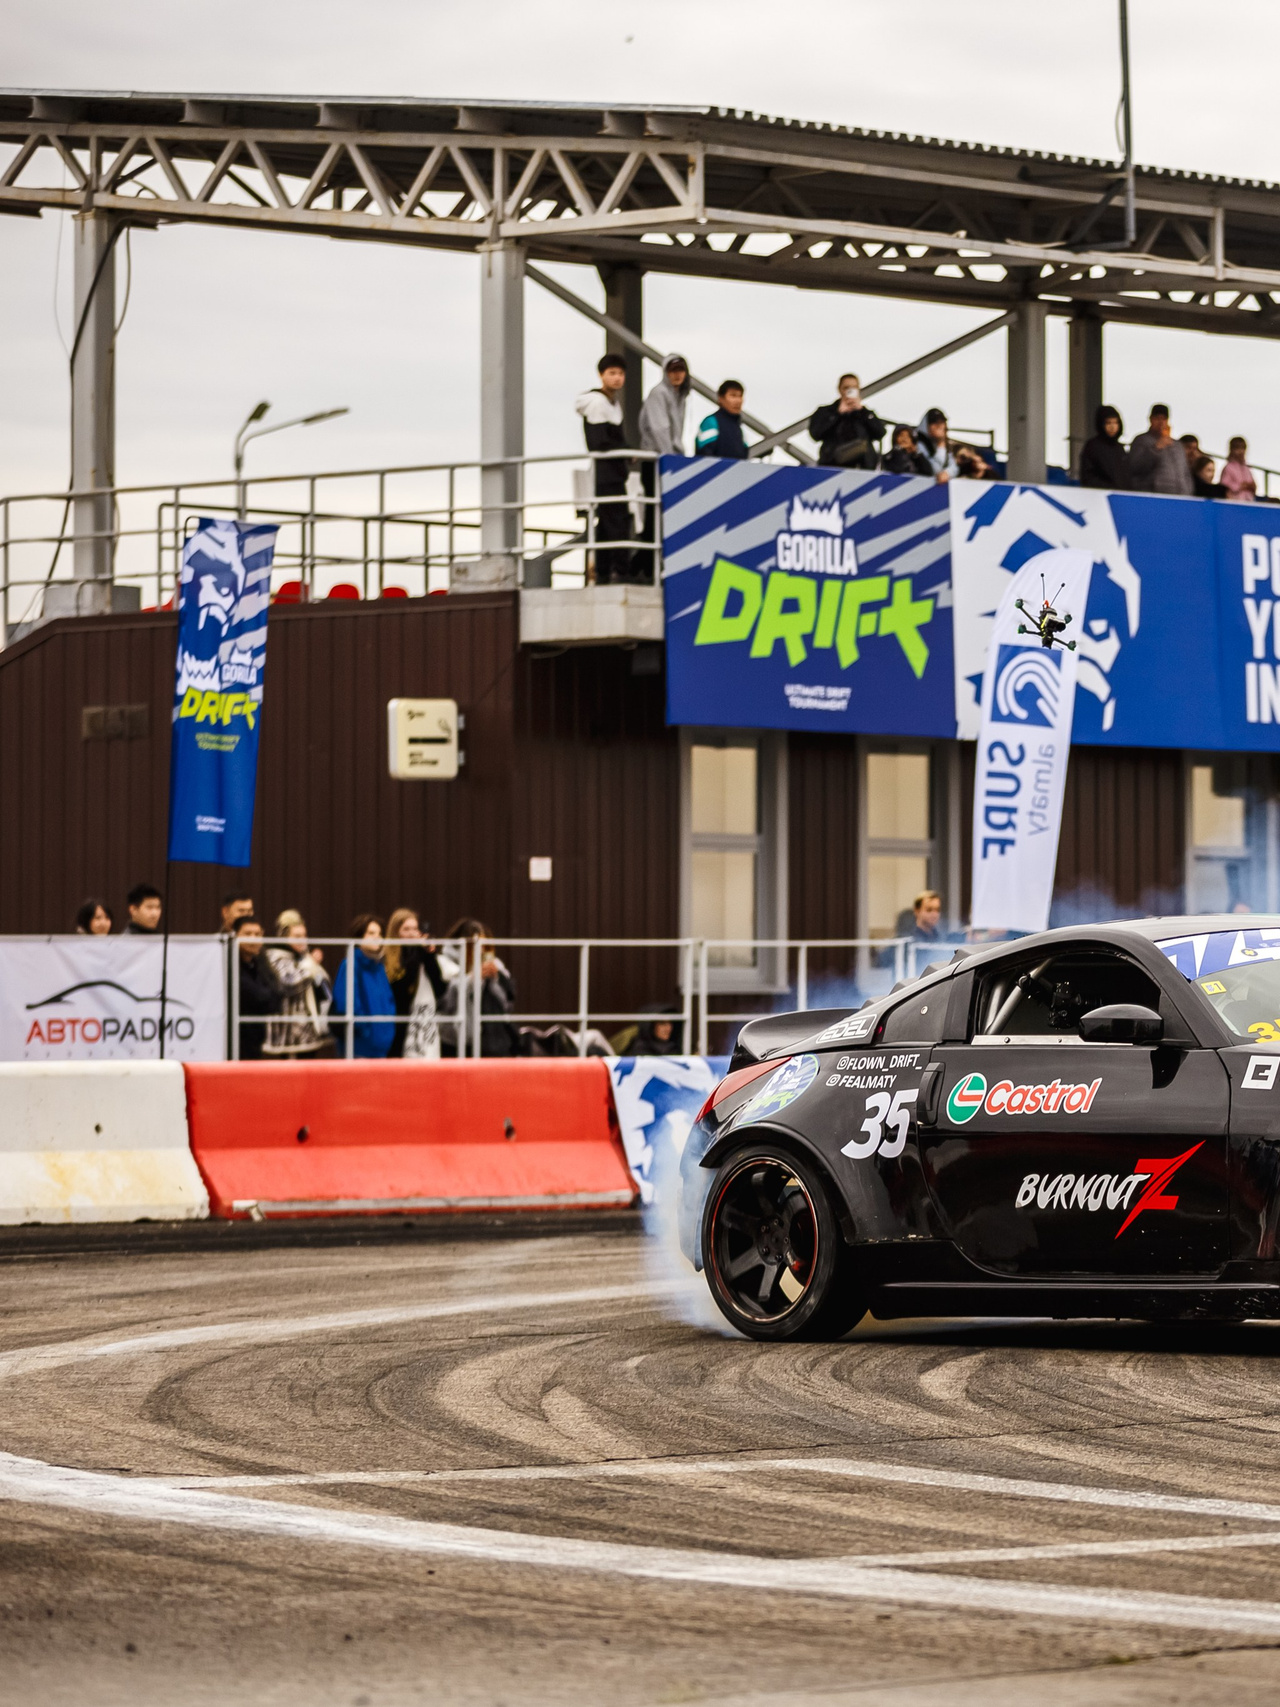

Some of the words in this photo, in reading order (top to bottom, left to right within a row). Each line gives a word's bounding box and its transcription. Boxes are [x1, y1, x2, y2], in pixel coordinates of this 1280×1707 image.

[777, 533, 858, 576] GORILLA
[984, 1076, 1103, 1116] Castrol
[840, 1088, 919, 1160] 35
